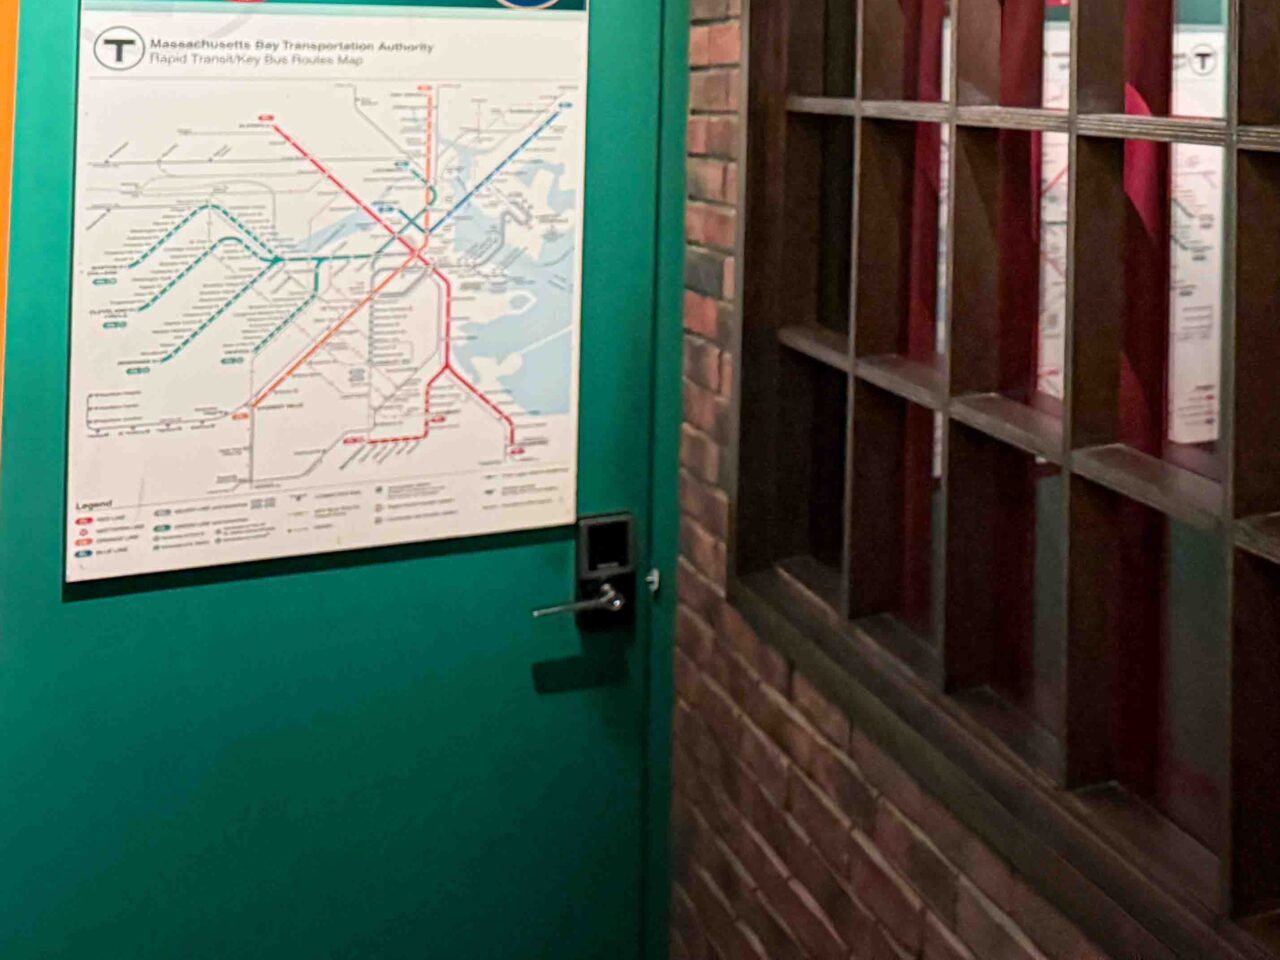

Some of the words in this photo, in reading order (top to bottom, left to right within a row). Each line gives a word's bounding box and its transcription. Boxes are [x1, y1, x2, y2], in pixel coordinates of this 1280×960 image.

[103, 38, 136, 63] T
[150, 38, 250, 51] Massachusetts
[254, 40, 280, 52] Bay
[283, 40, 374, 53] Transportation
[378, 41, 434, 54] Authority
[150, 53, 188, 66] Rapid
[192, 53, 261, 67] Transit/Key
[264, 54, 289, 65] Bus
[291, 54, 334, 66] Routes
[337, 55, 364, 67] Map
[75, 499, 113, 512] Legend
